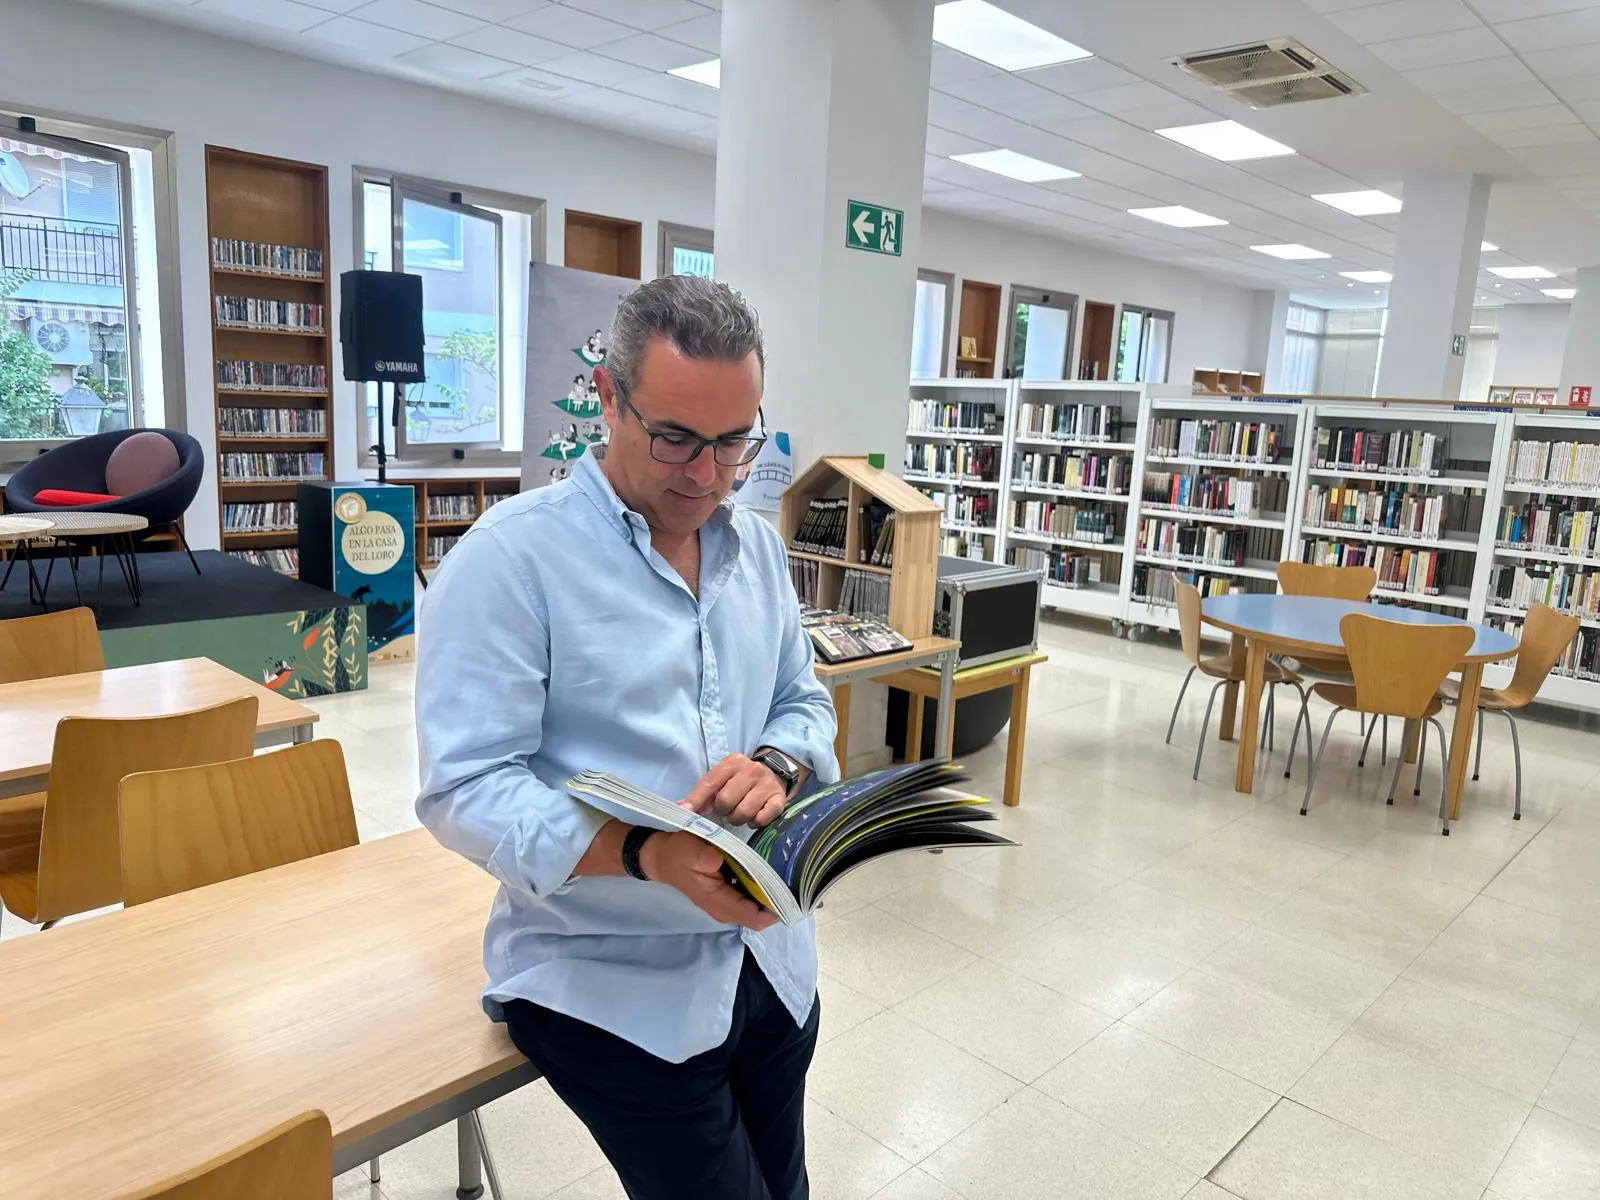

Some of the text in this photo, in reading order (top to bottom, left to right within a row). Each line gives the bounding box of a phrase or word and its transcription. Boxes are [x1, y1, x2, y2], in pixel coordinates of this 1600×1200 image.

[385, 361, 418, 373] YAMAHA
[350, 524, 396, 536] ALGO PASA
[349, 537, 398, 548] EN LA CASA
[352, 550, 395, 561] DEL LOBO
